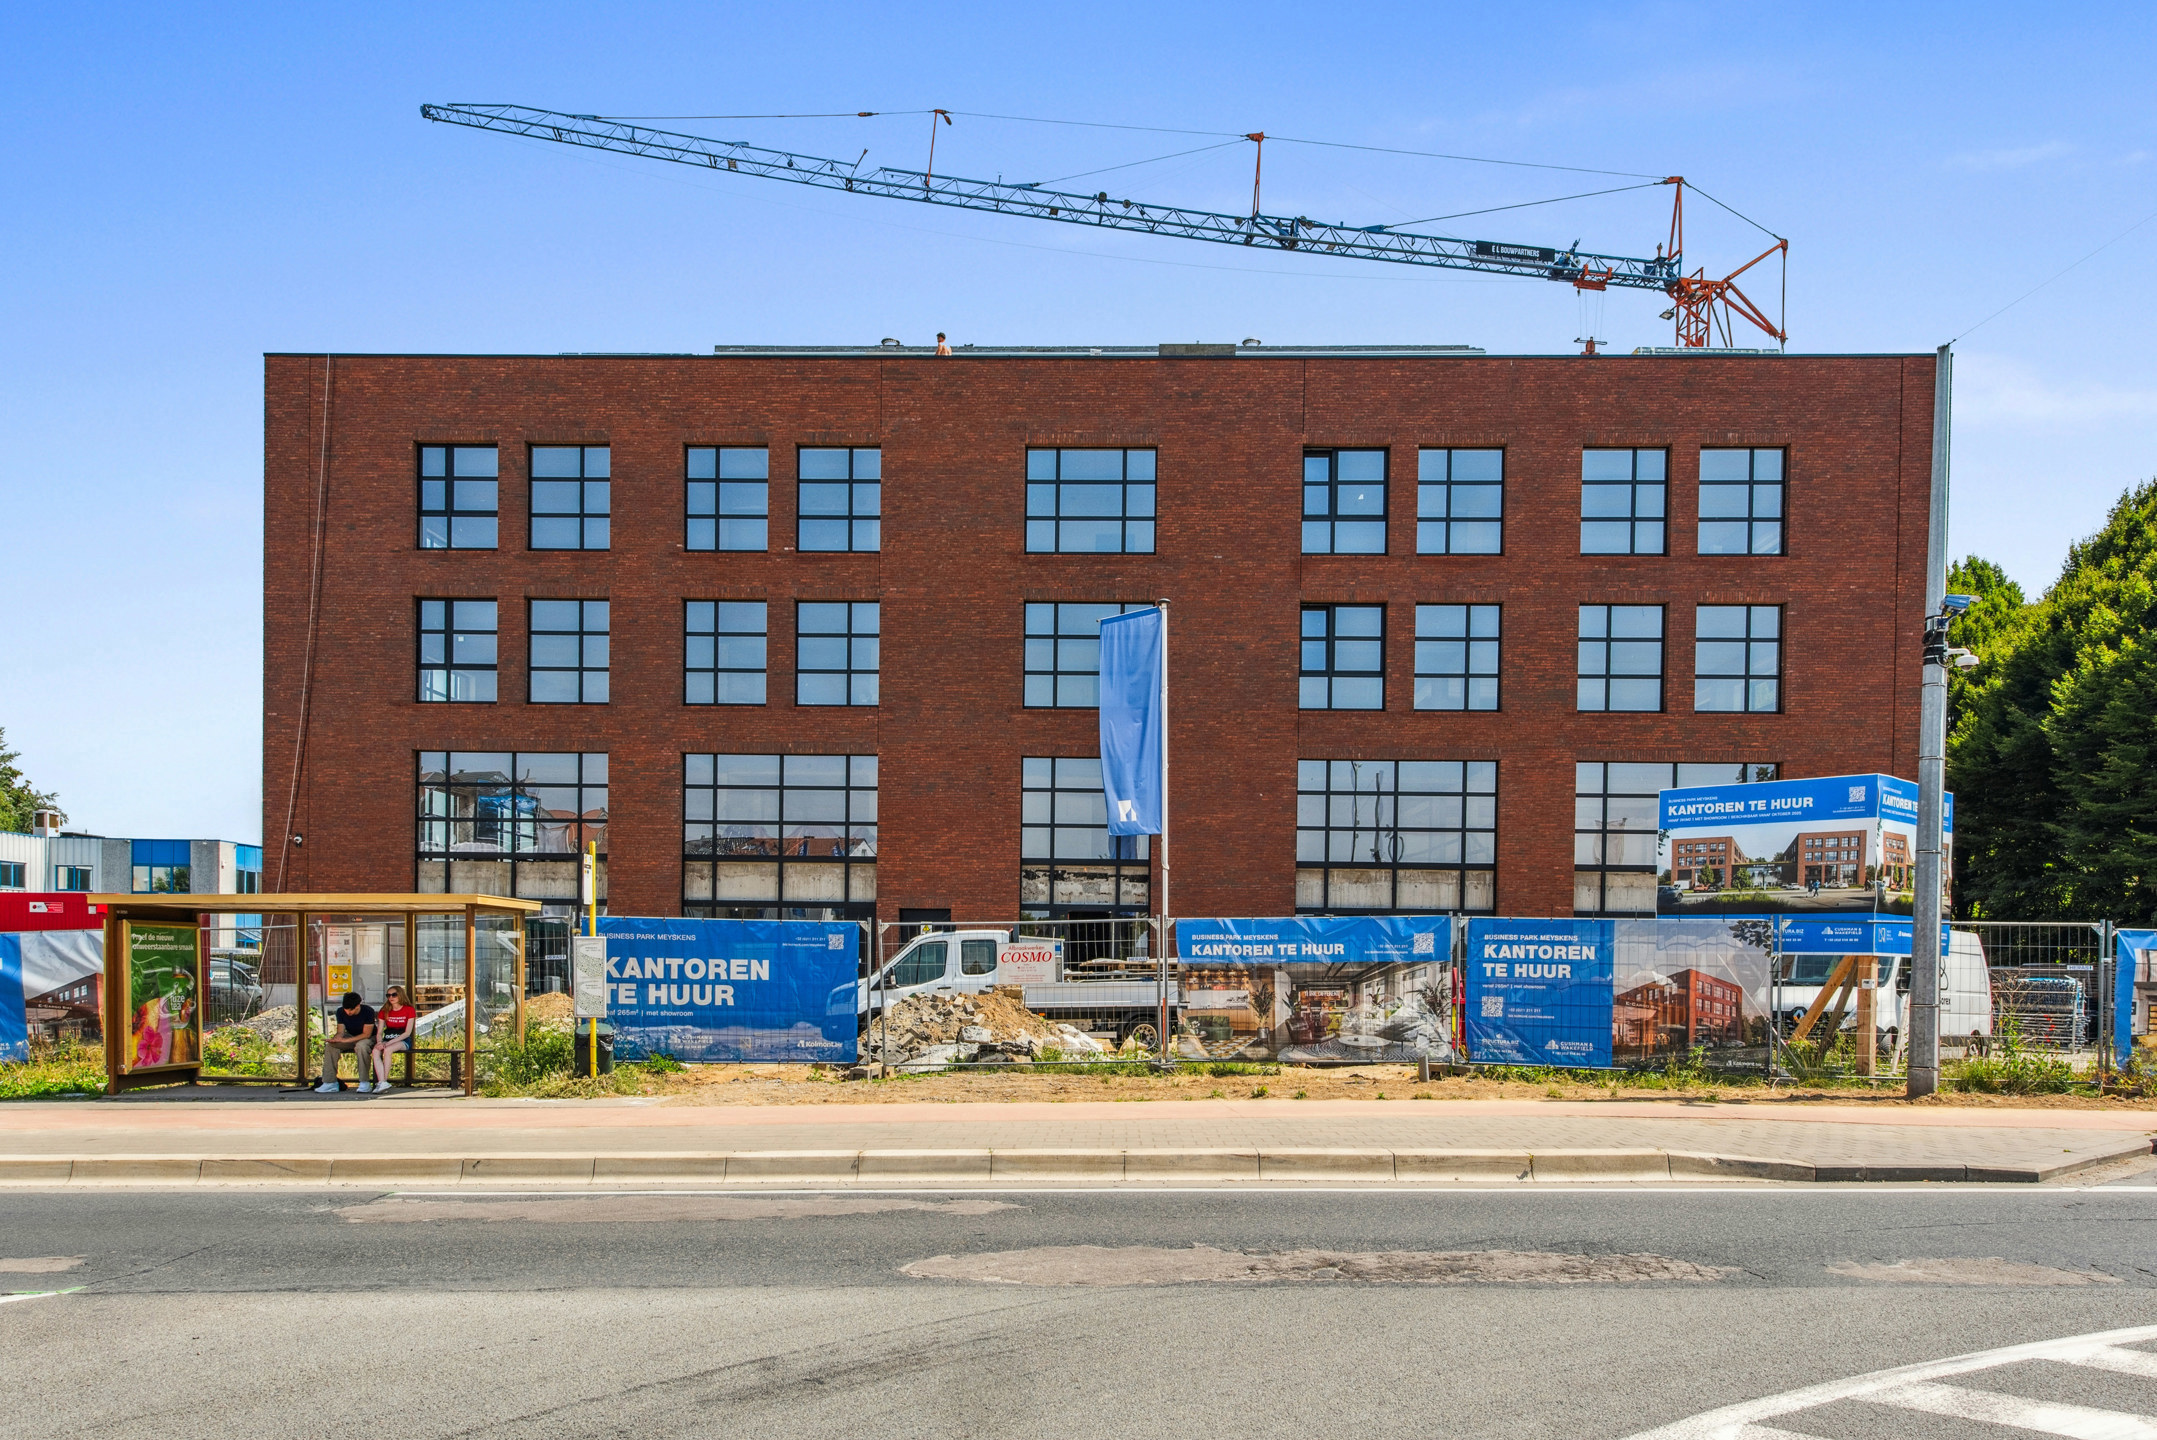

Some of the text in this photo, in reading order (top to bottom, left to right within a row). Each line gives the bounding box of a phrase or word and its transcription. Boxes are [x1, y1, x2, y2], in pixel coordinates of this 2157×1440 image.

[1501, 246, 1540, 257] BOUWPARTNERS
[1668, 797, 1814, 816] KANTOREN TE HUUR
[1882, 793, 1912, 811] KANTOREN
[148, 933, 155, 941] de
[1540, 934, 1578, 942] MEYSKENS
[1001, 951, 1053, 963] COSMO
[1191, 943, 1345, 956] KANTOREN TE HUUR
[1484, 944, 1596, 960] KANTOREN
[606, 957, 770, 981] KANTOREN
[1482, 963, 1571, 979] TE HUUR
[648, 983, 735, 1006] HUUR
